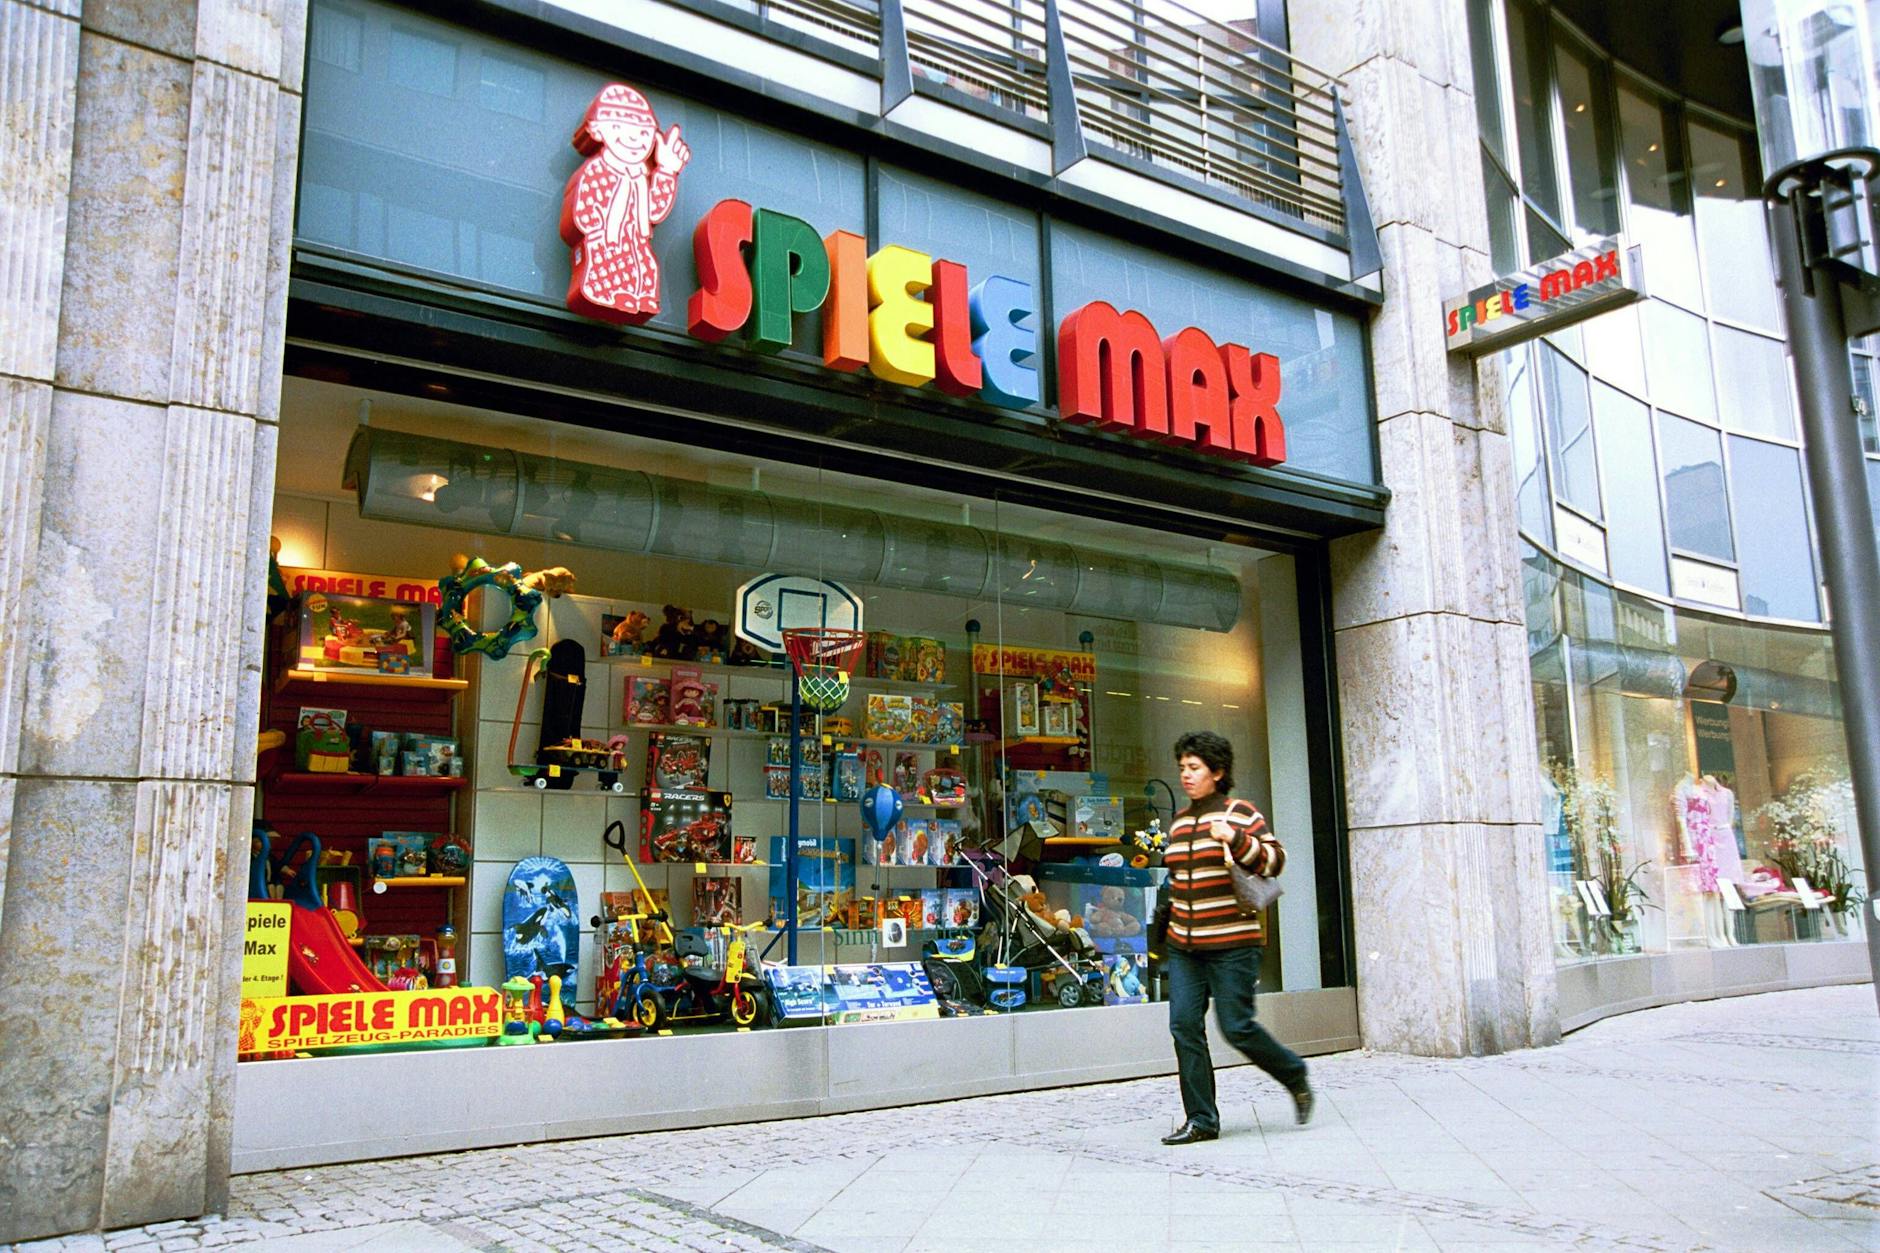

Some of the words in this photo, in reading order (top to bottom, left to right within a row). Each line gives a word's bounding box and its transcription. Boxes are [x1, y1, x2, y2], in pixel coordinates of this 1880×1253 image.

[1448, 283, 1529, 336] SPIELE
[1540, 250, 1618, 301] MAX
[688, 199, 1040, 409] SPIELE
[1058, 300, 1286, 467] MAX
[396, 583, 443, 608] MA
[989, 649, 1047, 673] SPIELE
[663, 792, 705, 801] RACERS
[248, 913, 287, 932] piele
[243, 940, 277, 956] Max
[268, 999, 394, 1038] SPIELE
[409, 993, 499, 1028] MAX
[267, 1025, 499, 1050] SPIELZEUG-PARADIES
